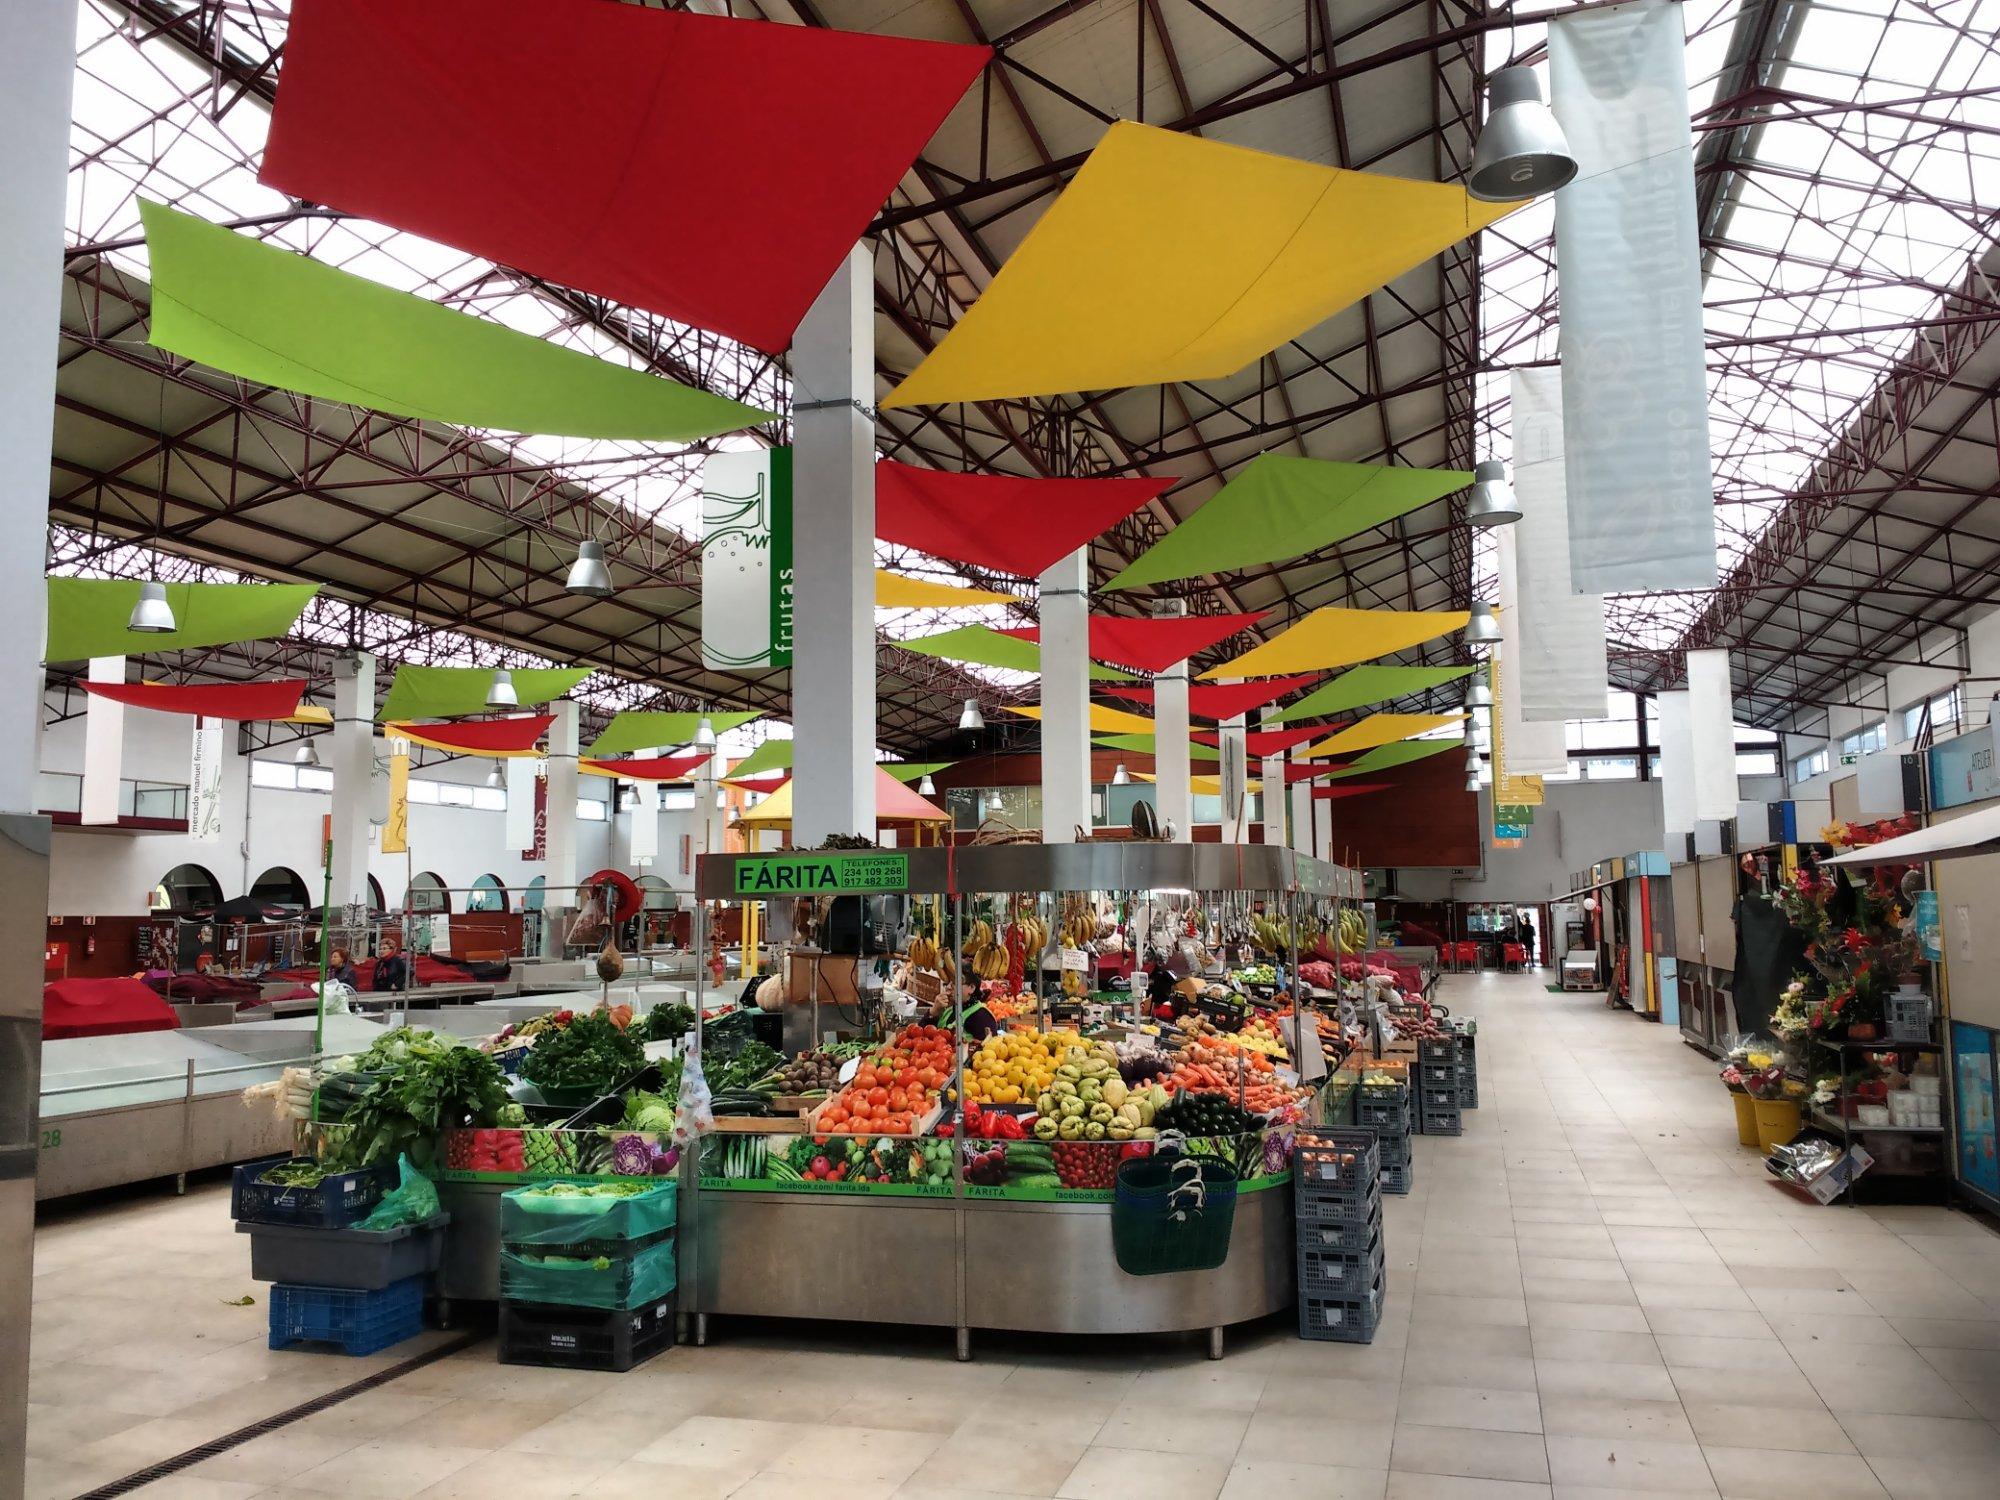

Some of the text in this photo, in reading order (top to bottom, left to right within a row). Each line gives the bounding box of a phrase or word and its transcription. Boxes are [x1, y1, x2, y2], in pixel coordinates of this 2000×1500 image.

[774, 568, 793, 653] frutas
[192, 731, 203, 833] mercado manuel firmino
[739, 861, 838, 890] FÁRITA
[844, 867, 902, 877] 234 109 268
[844, 876, 902, 886] 917 482 303
[42, 1129, 61, 1150] 28
